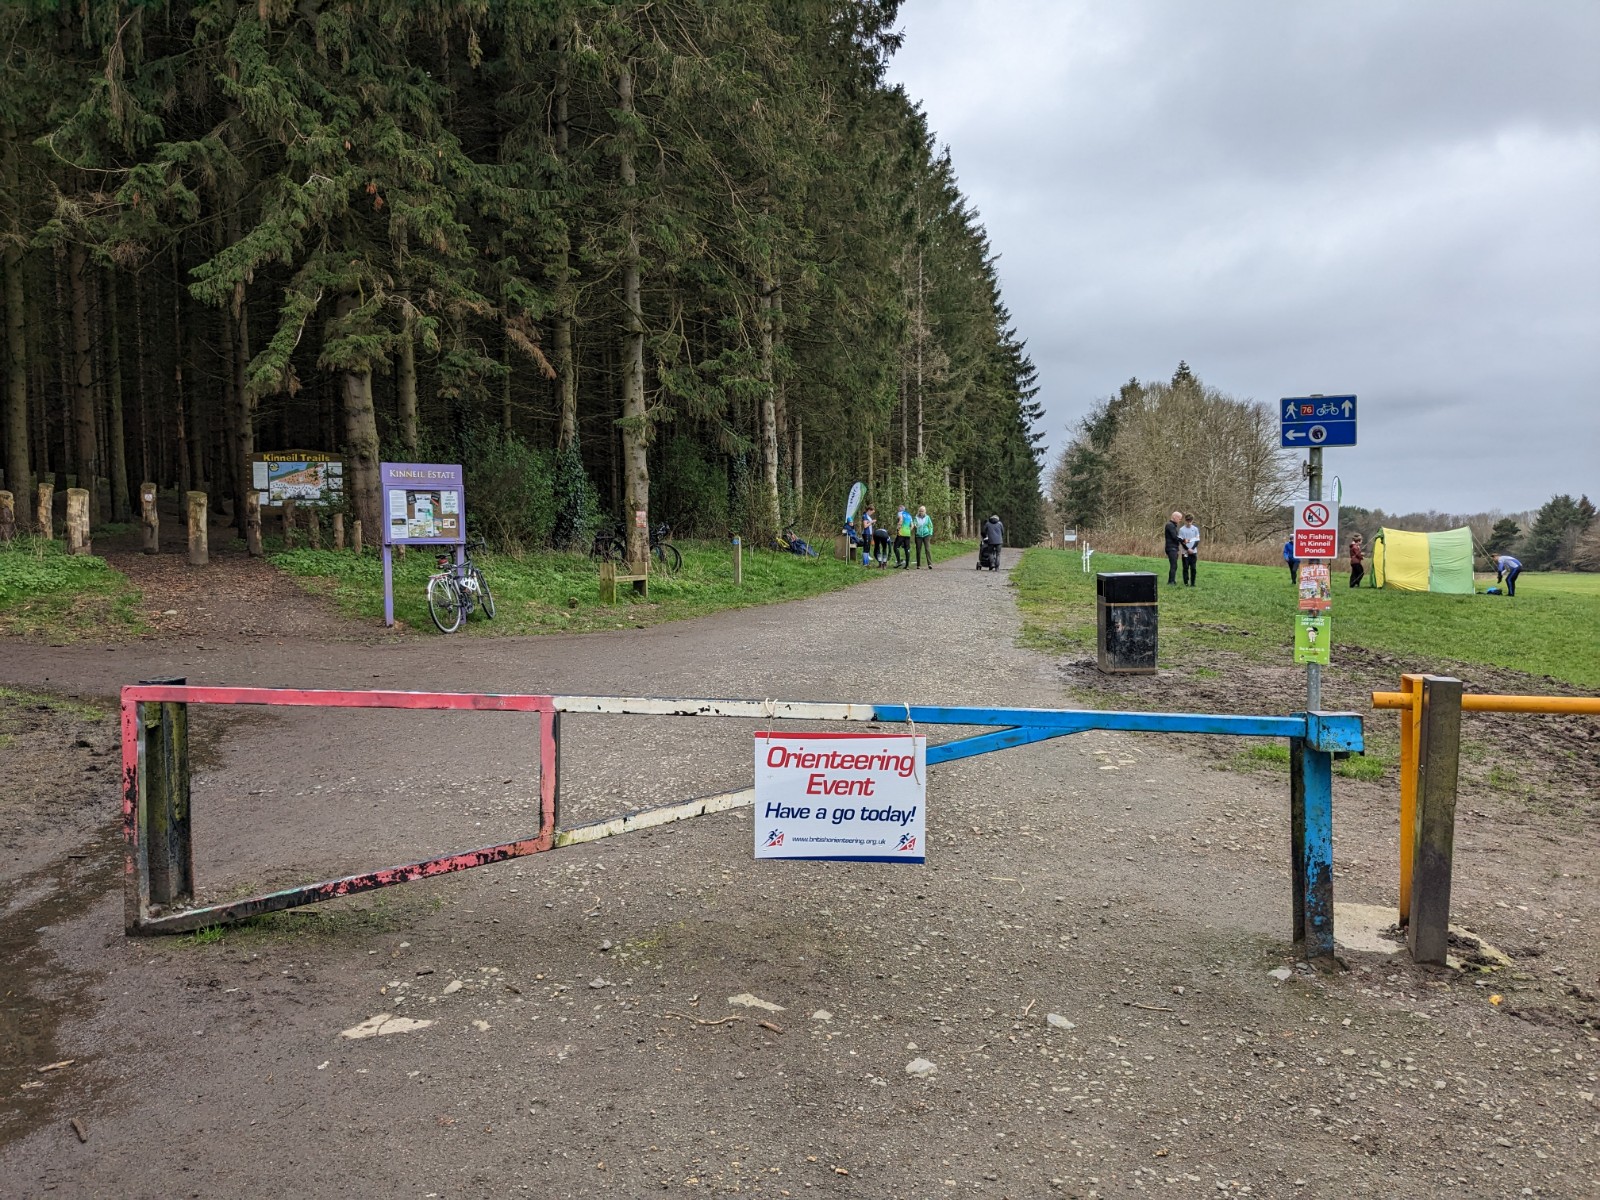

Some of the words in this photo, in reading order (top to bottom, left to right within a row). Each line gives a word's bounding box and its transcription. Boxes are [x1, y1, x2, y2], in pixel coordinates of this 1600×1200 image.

[263, 453, 298, 461] Kinneil
[300, 453, 330, 461] Trails
[389, 469, 425, 478] KINNEIL
[427, 470, 455, 479] ESTATE
[766, 746, 915, 777] Orienteering
[806, 773, 875, 796] Event
[765, 802, 810, 819] Have
[815, 807, 827, 819] a
[832, 806, 855, 825] go
[860, 806, 917, 826] today!
[791, 836, 886, 845] www.britishorienteering.org.uk
